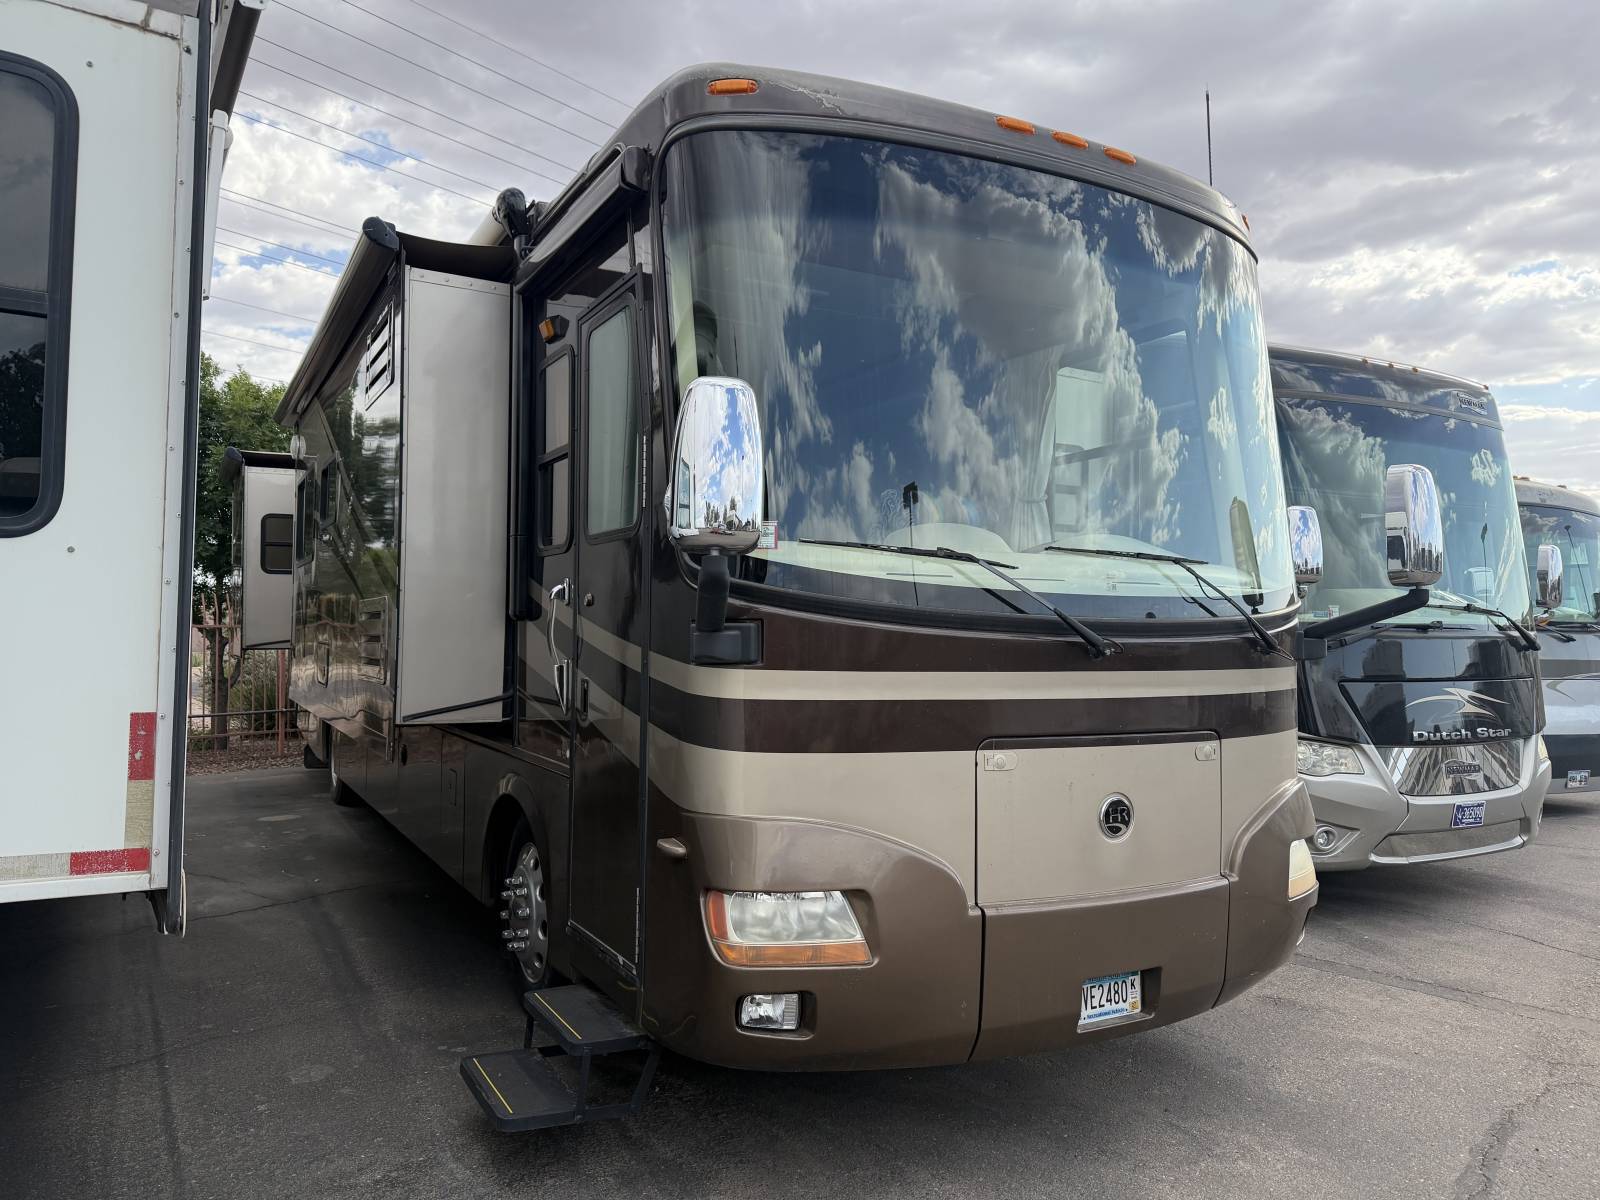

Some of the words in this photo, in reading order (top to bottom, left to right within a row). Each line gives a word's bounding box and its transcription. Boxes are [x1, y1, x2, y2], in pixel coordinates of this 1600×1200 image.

[1412, 729, 1472, 741] Dutch
[1476, 727, 1512, 738] Star
[1109, 806, 1129, 823] HR
[1082, 980, 1128, 1011] VE2480
